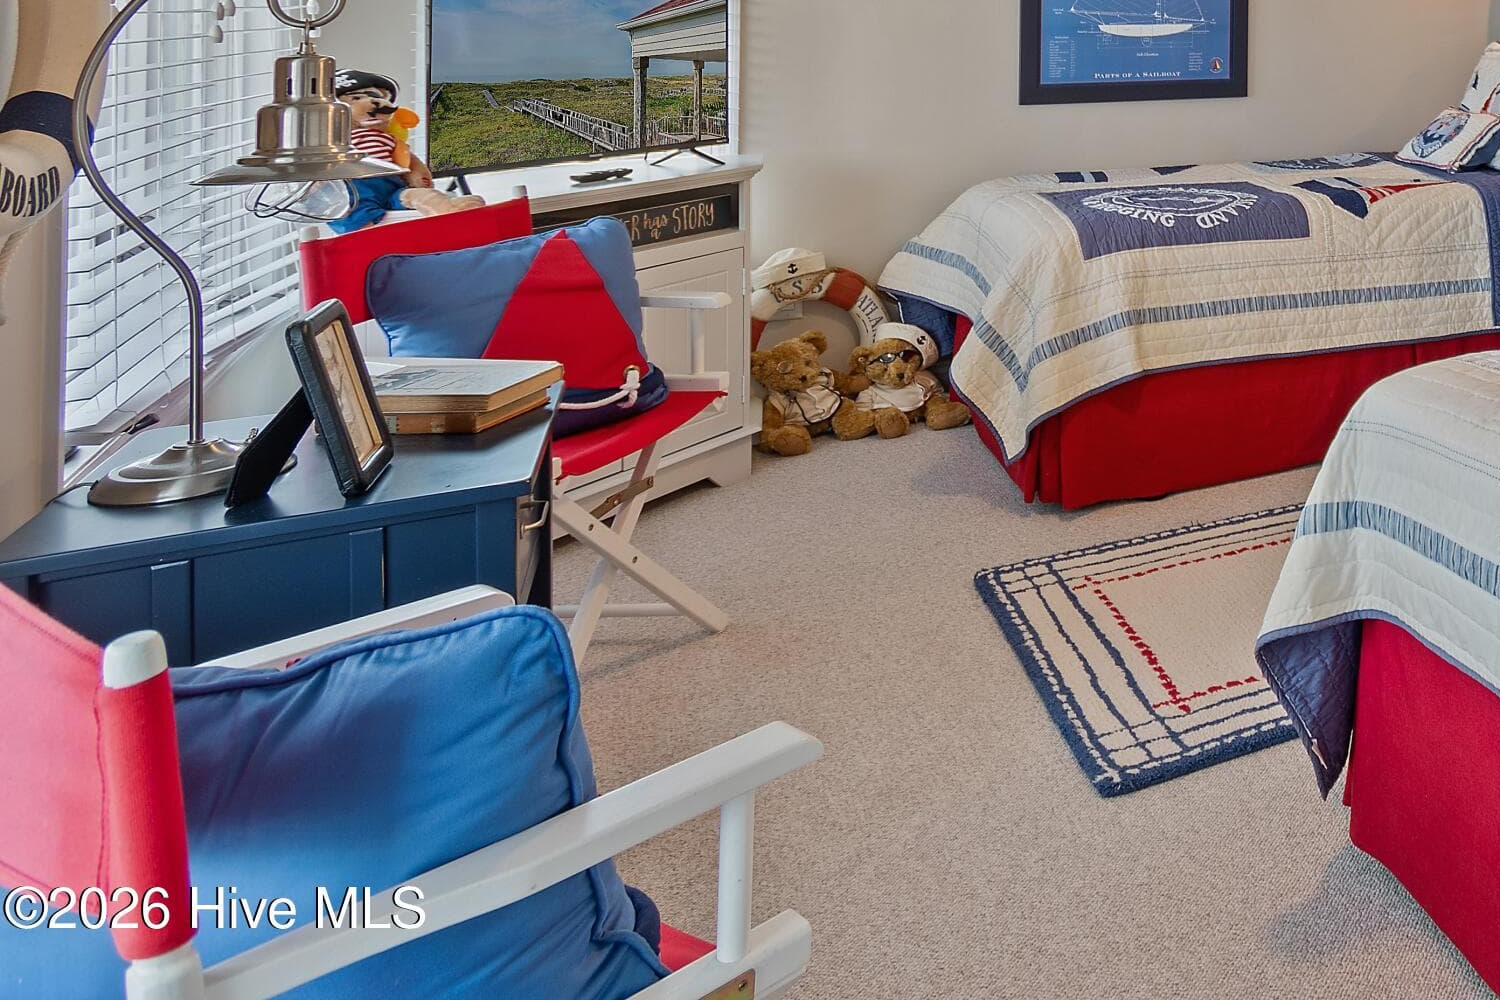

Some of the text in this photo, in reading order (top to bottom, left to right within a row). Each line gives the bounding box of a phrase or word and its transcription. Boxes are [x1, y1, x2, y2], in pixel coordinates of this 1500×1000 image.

[1094, 72, 1120, 80] PARTS
[1142, 70, 1182, 78] SAILBOAT
[0, 162, 60, 218] BOARD
[643, 212, 668, 230] has
[672, 202, 714, 234] STORY
[650, 228, 661, 239] a
